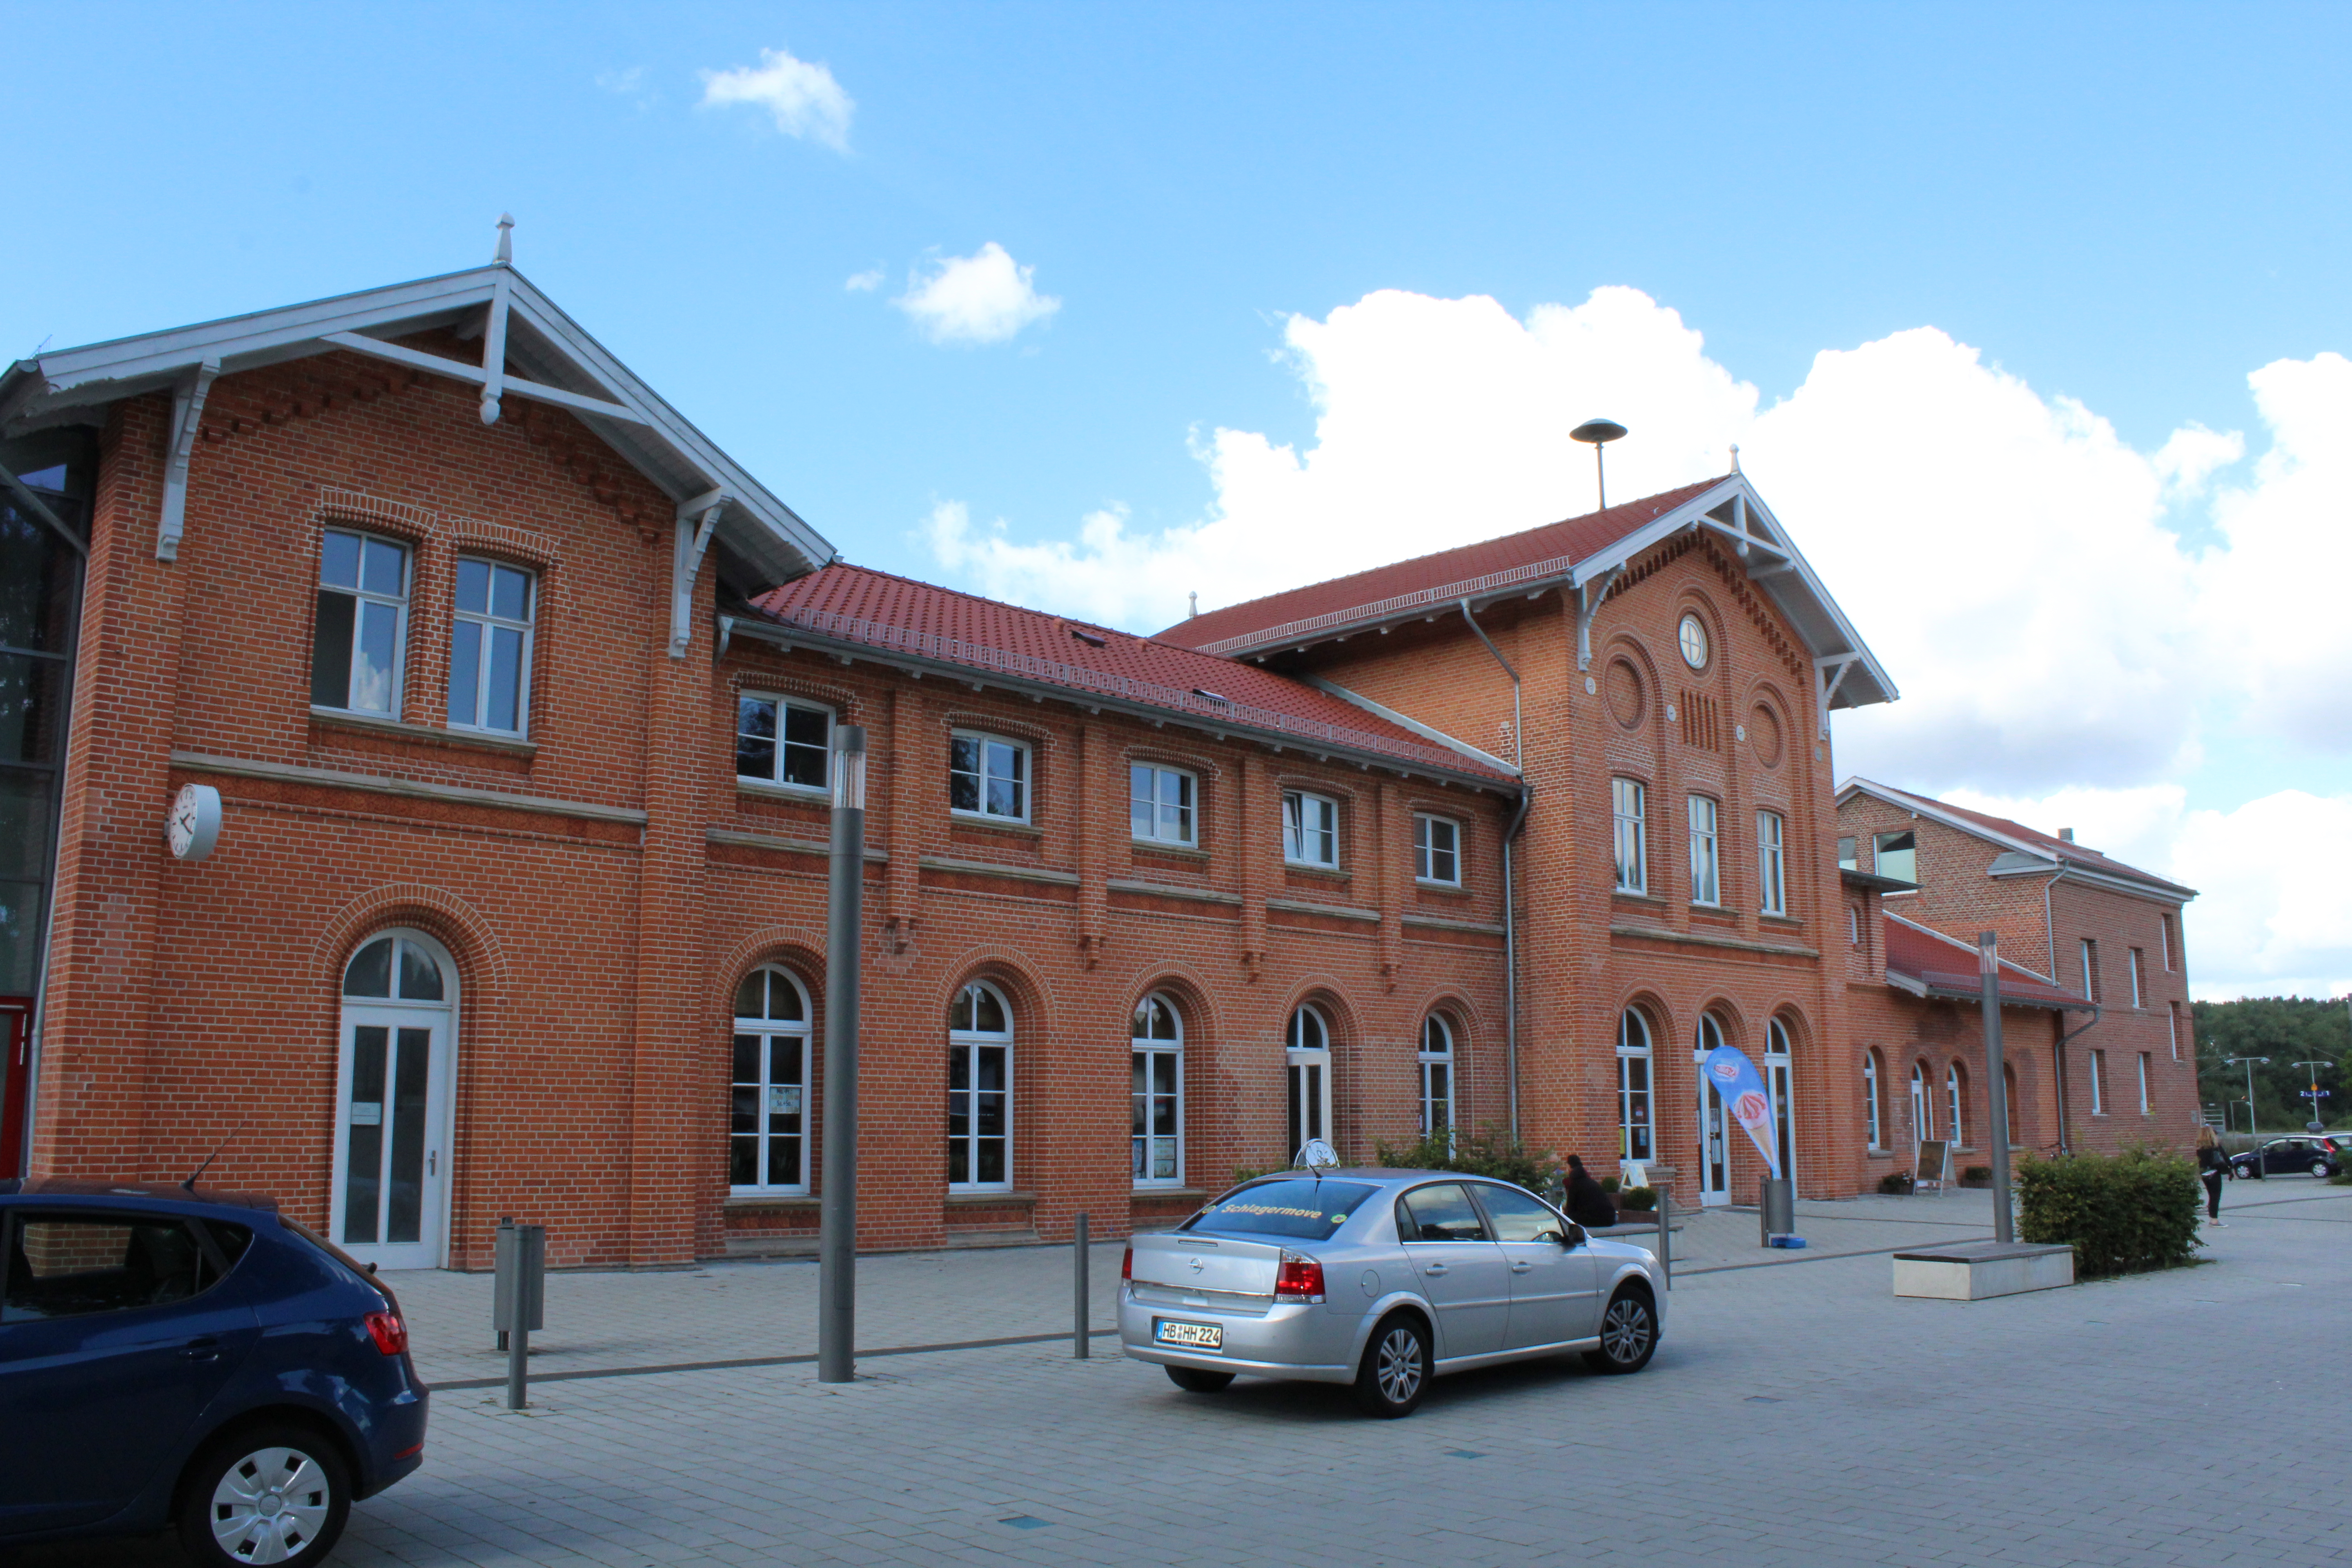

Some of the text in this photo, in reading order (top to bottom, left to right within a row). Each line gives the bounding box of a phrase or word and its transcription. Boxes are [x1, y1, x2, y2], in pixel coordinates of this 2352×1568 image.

[1221, 1204, 1322, 1219] Schlagermove
[1163, 1324, 1220, 1343] HB HH 224
